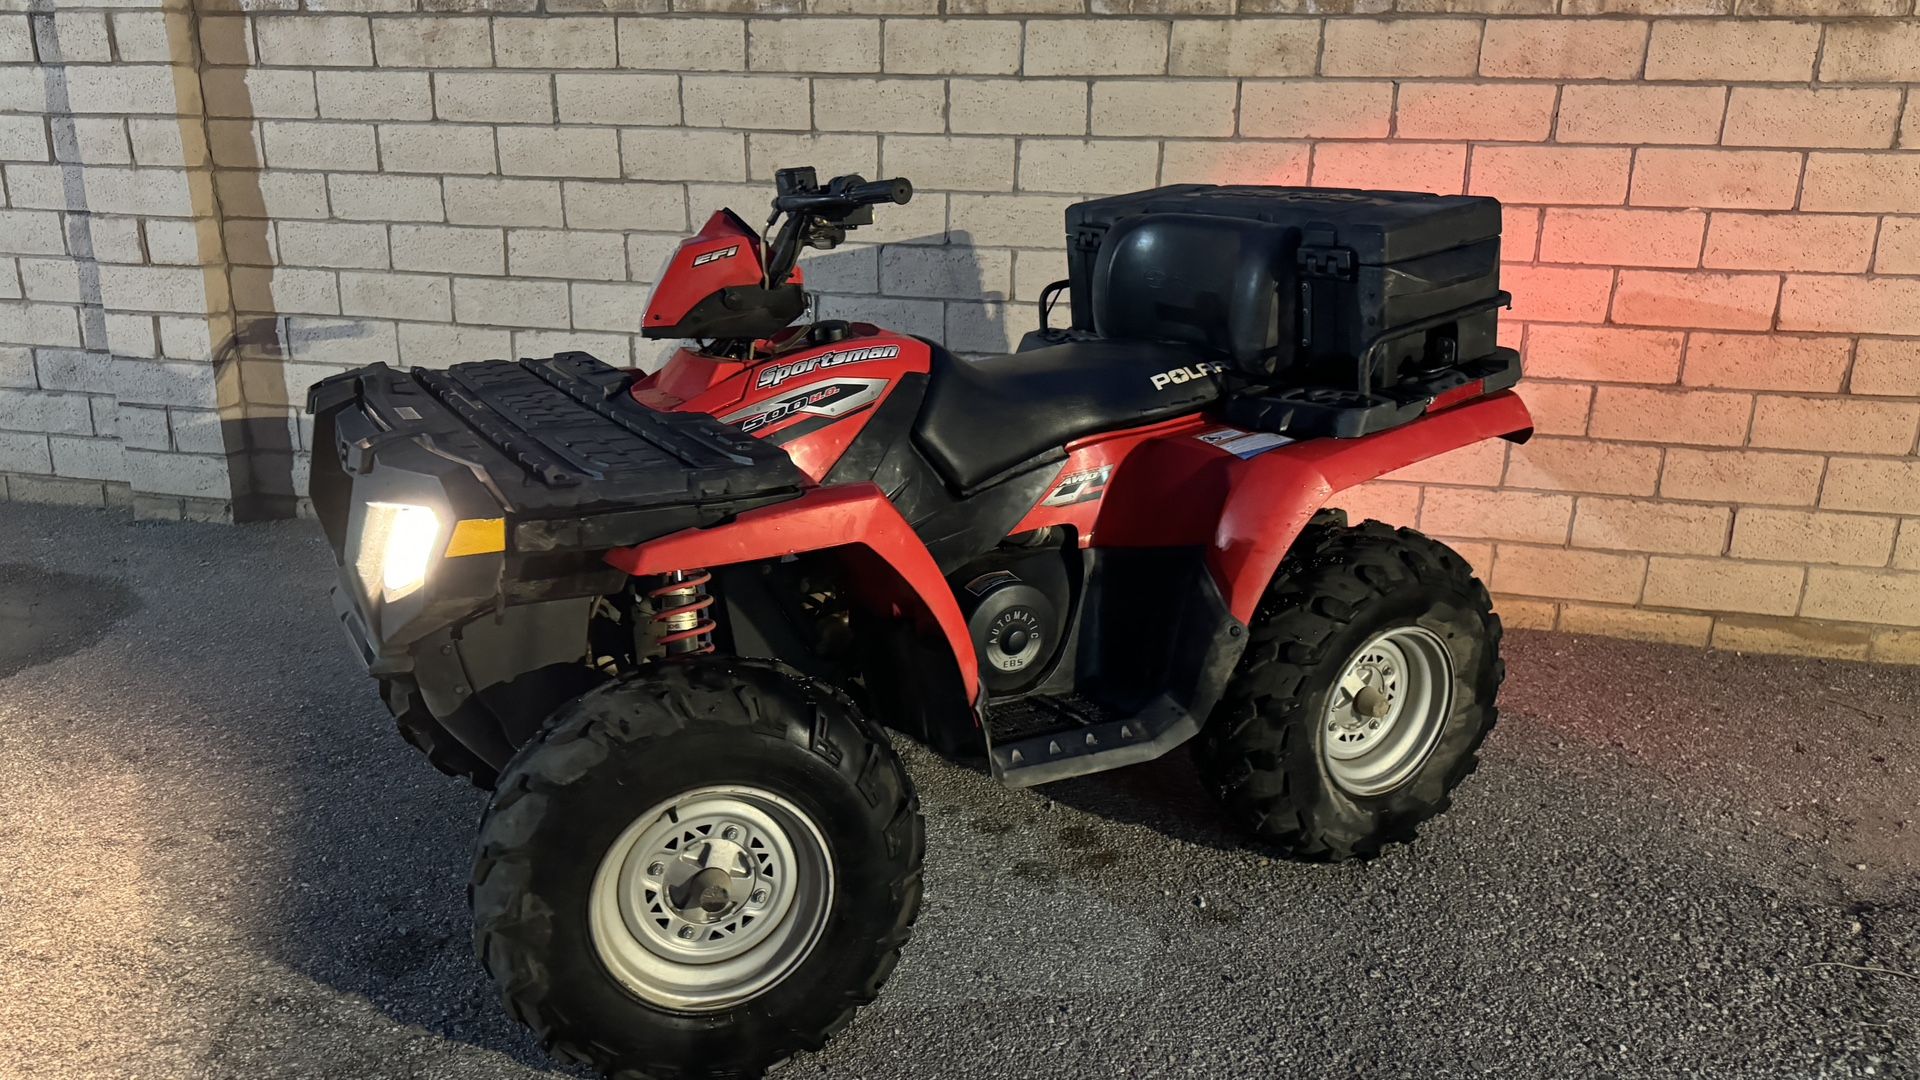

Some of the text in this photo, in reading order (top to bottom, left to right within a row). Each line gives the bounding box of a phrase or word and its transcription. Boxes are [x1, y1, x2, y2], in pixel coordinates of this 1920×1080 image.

[693, 246, 739, 267] EFI
[756, 344, 899, 389] Sportsman
[742, 397, 808, 432] 500
[988, 610, 1040, 645] AUTOMATIC
[1003, 658, 1024, 669] EBS
